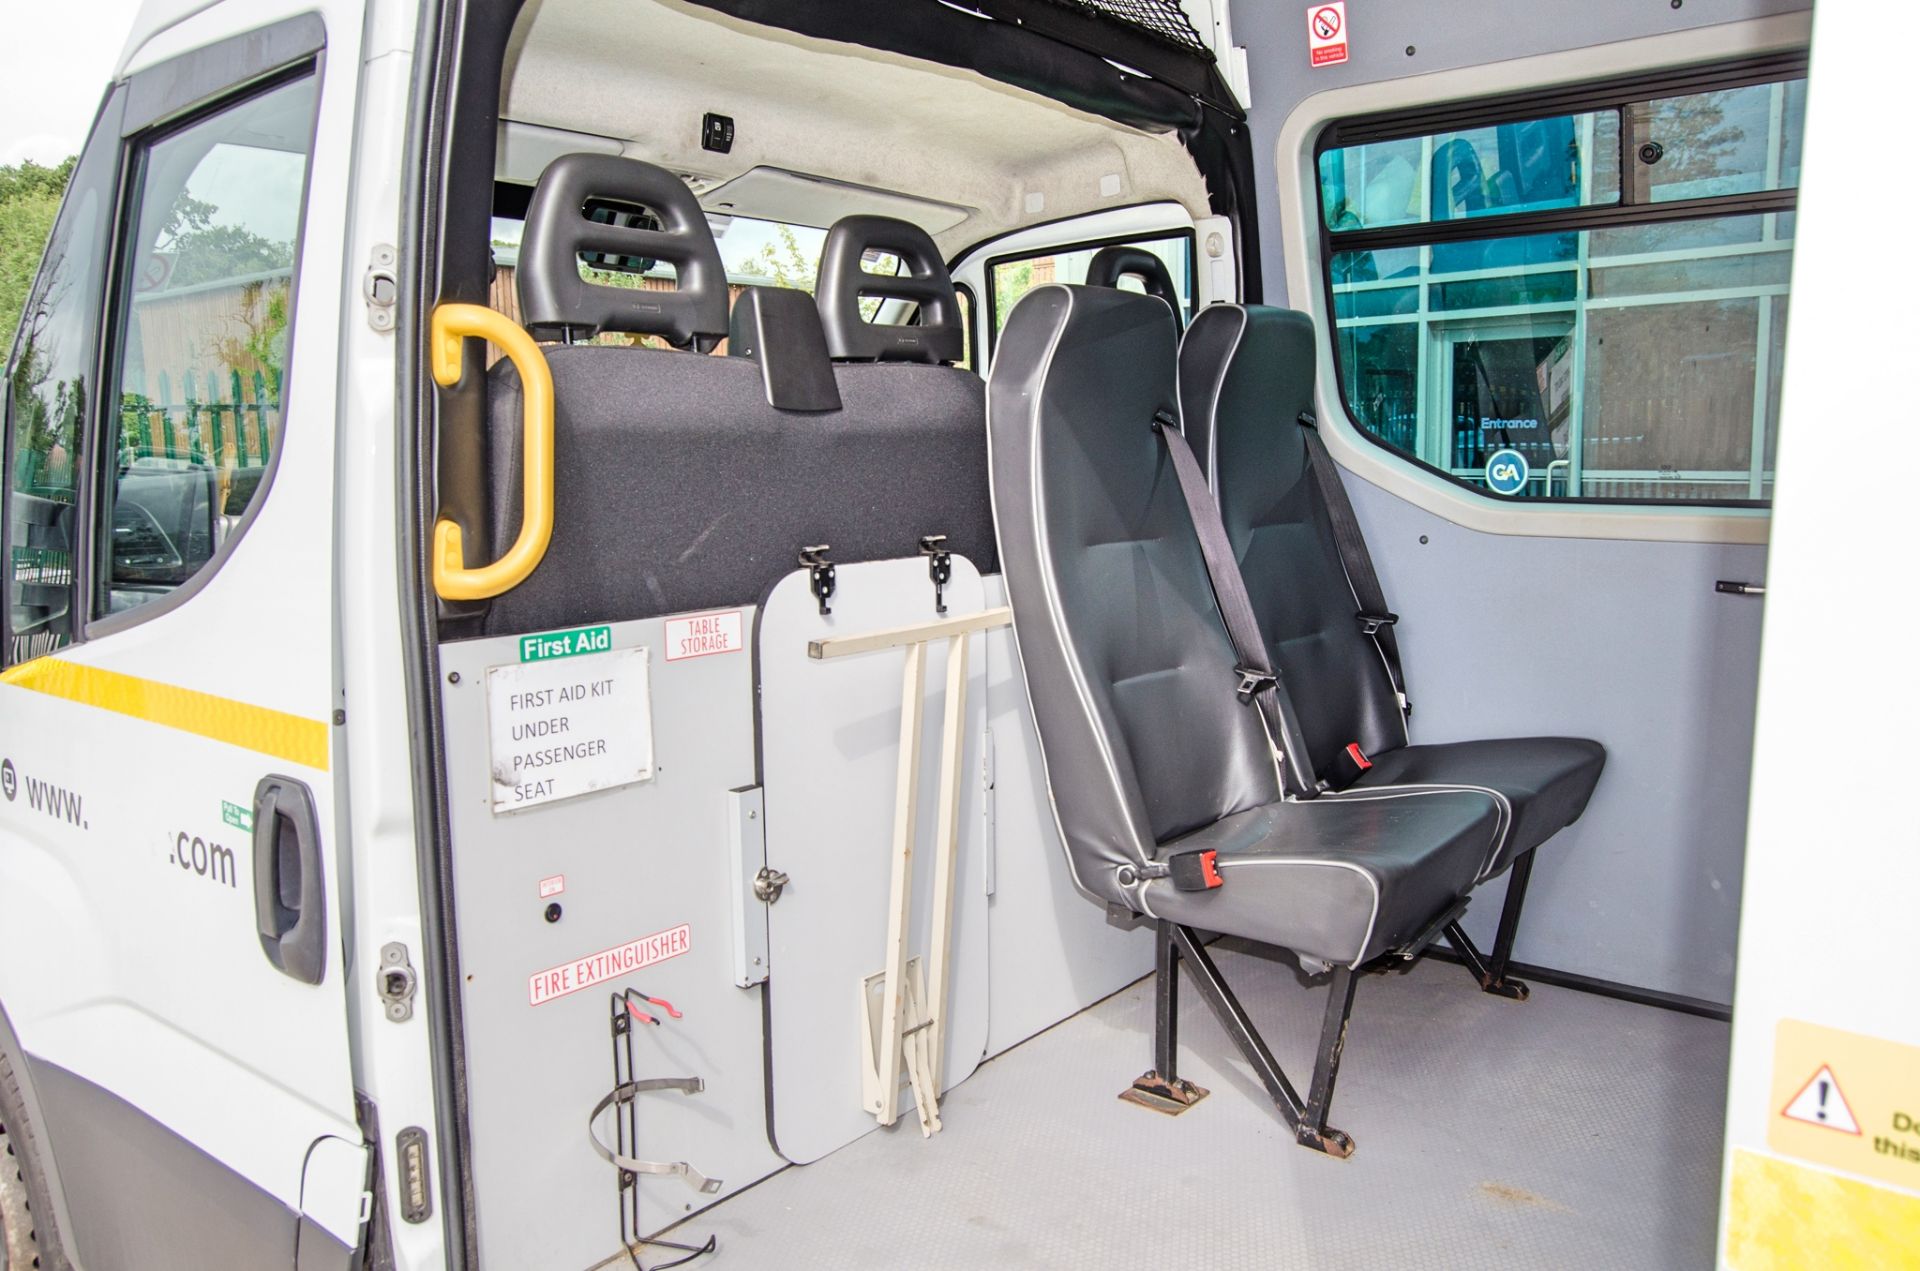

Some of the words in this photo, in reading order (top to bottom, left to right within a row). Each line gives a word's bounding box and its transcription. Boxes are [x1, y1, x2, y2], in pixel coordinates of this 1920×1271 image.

[1481, 417, 1538, 429] Entrance
[688, 617, 720, 636] TABLE
[523, 637, 572, 660] First
[575, 629, 609, 652] Aid
[680, 633, 729, 655] STORAGE
[510, 688, 554, 711] FIRST
[559, 684, 586, 703] AID
[590, 679, 614, 697] KIT
[511, 716, 570, 741] UNDER
[513, 738, 607, 771] PASSENGER
[25, 775, 88, 830] www.
[514, 779, 555, 802] SEAT
[170, 831, 237, 888] .com
[534, 967, 570, 999] FIRE
[576, 929, 688, 985] EXTINGUISHER
